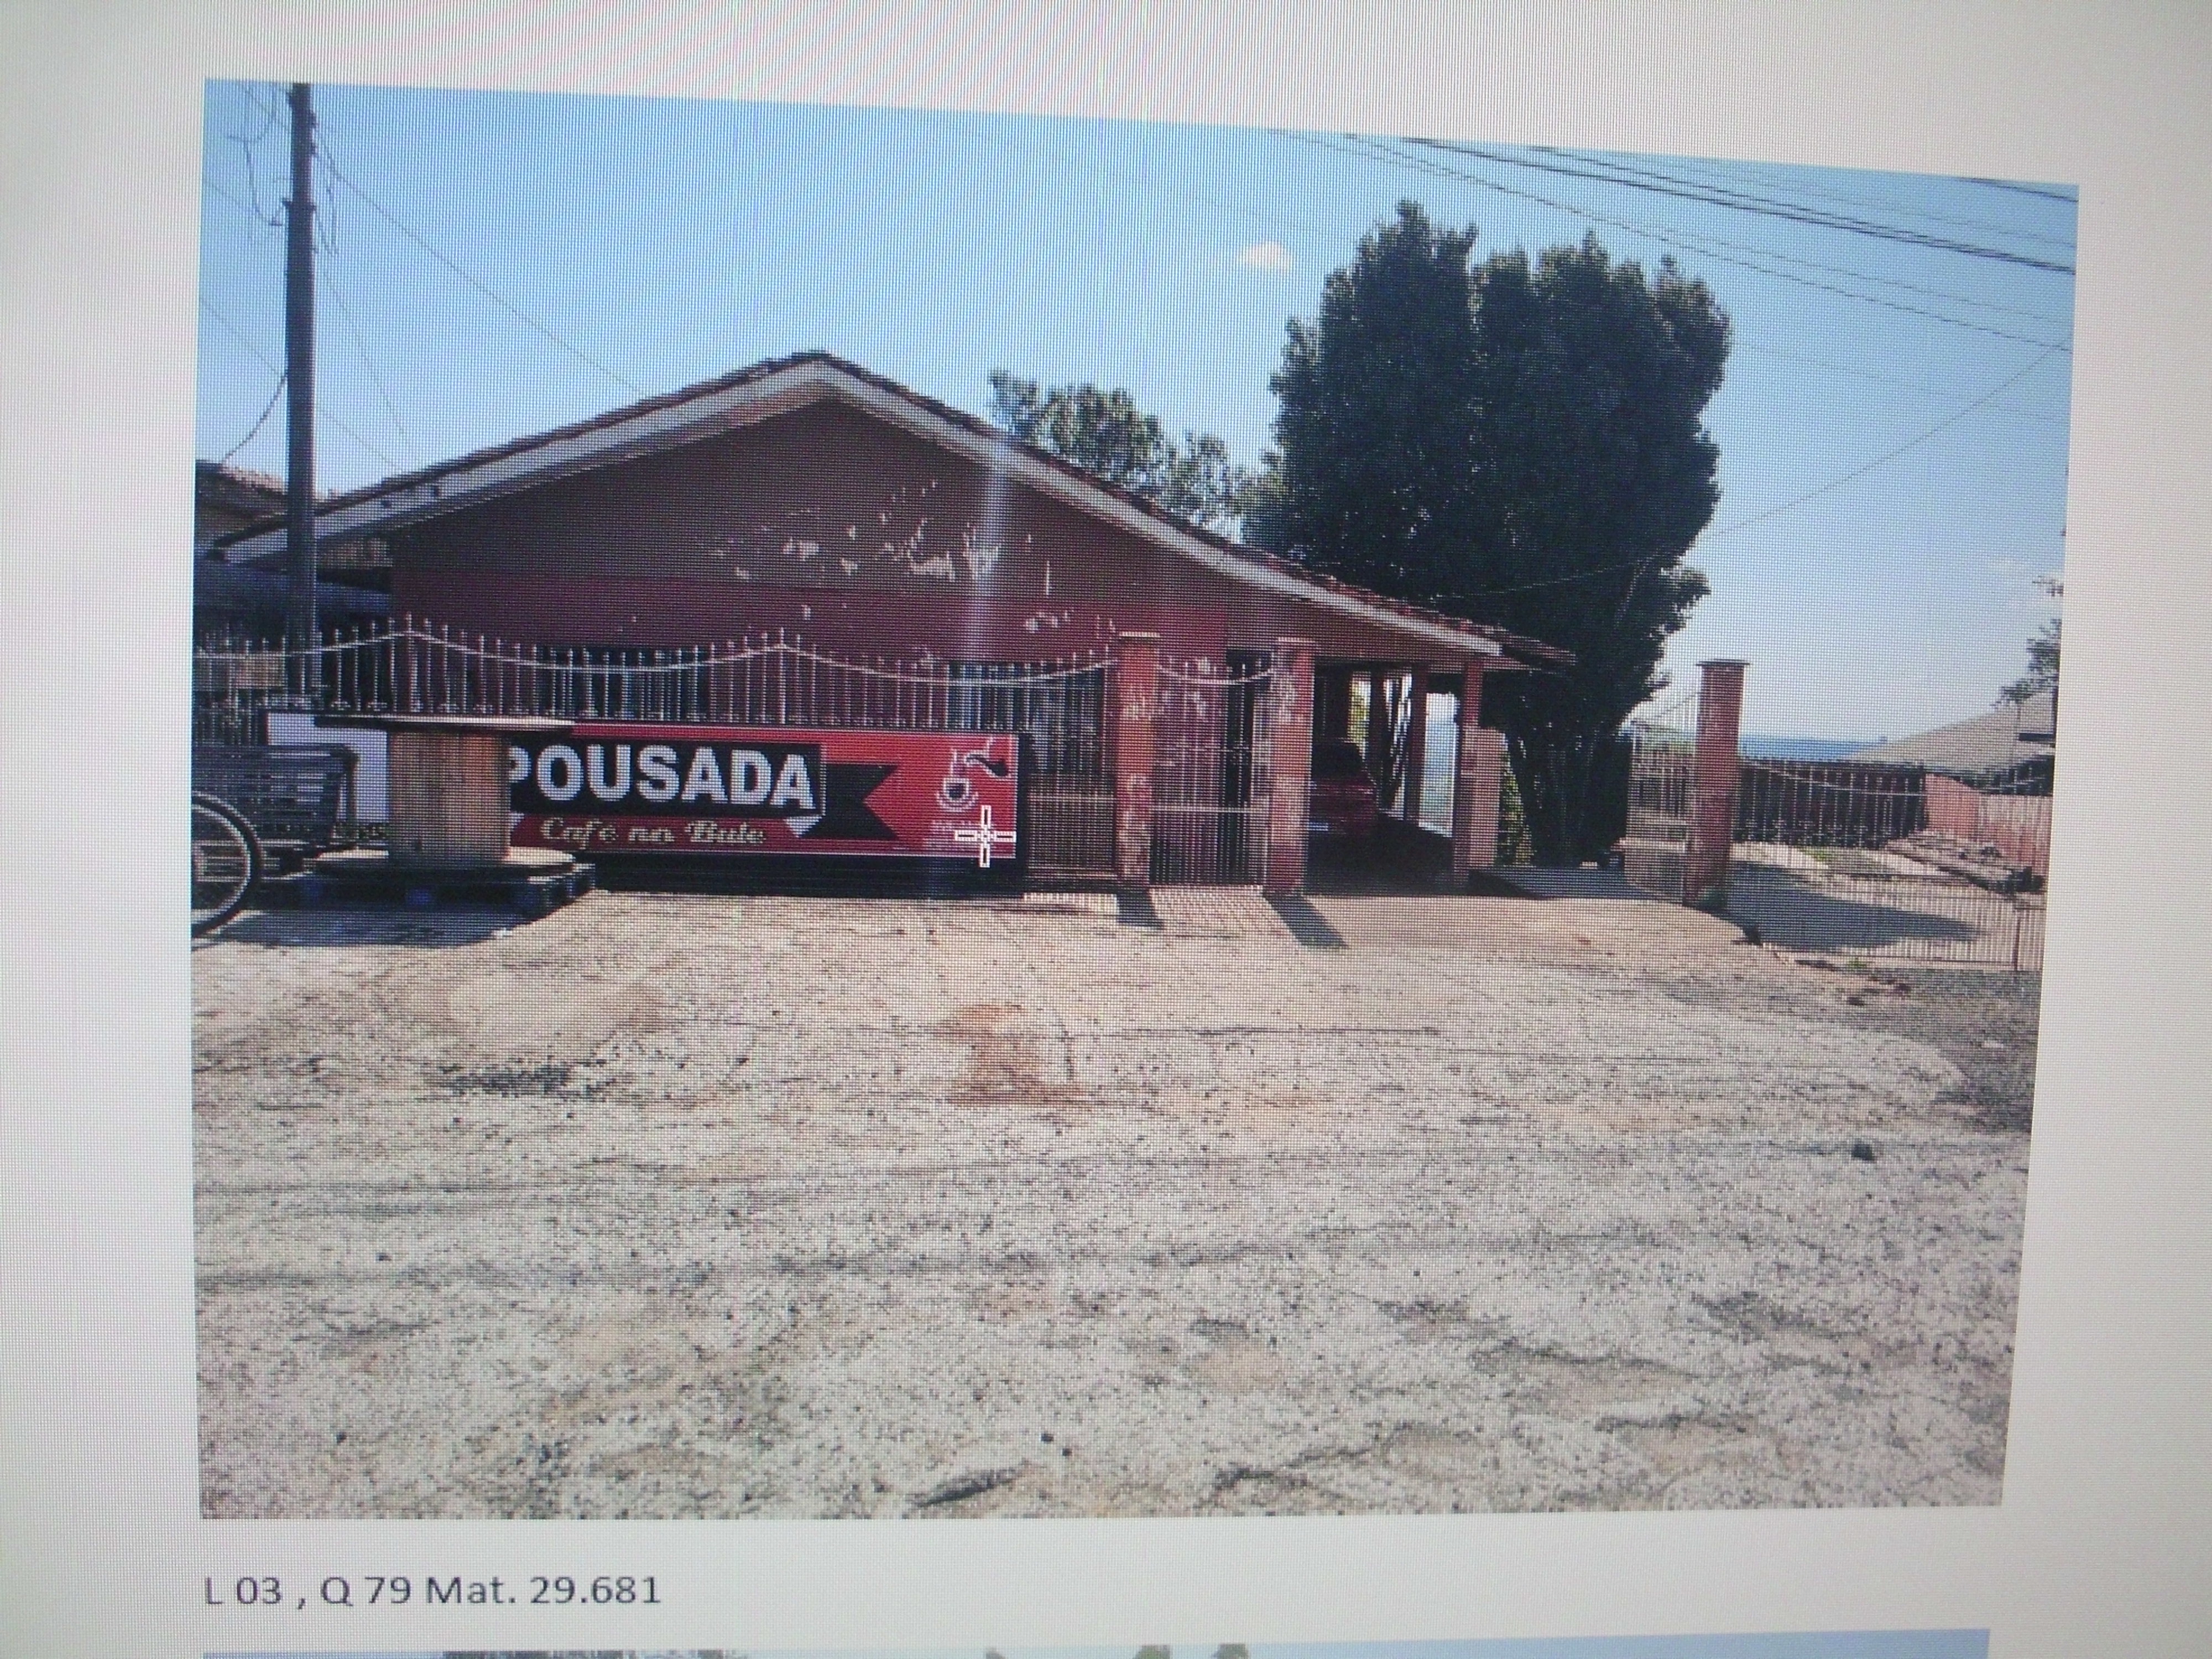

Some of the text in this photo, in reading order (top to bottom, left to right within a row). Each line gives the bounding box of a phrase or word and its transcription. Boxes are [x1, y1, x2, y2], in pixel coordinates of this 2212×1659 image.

[508, 744, 816, 809] POUSADA
[205, 1577, 222, 1604] L
[236, 1577, 282, 1605] 03
[320, 1577, 353, 1606] Q
[366, 1577, 412, 1605] 79
[426, 1576, 516, 1605] Mat.
[529, 1576, 661, 1605] 29.681
